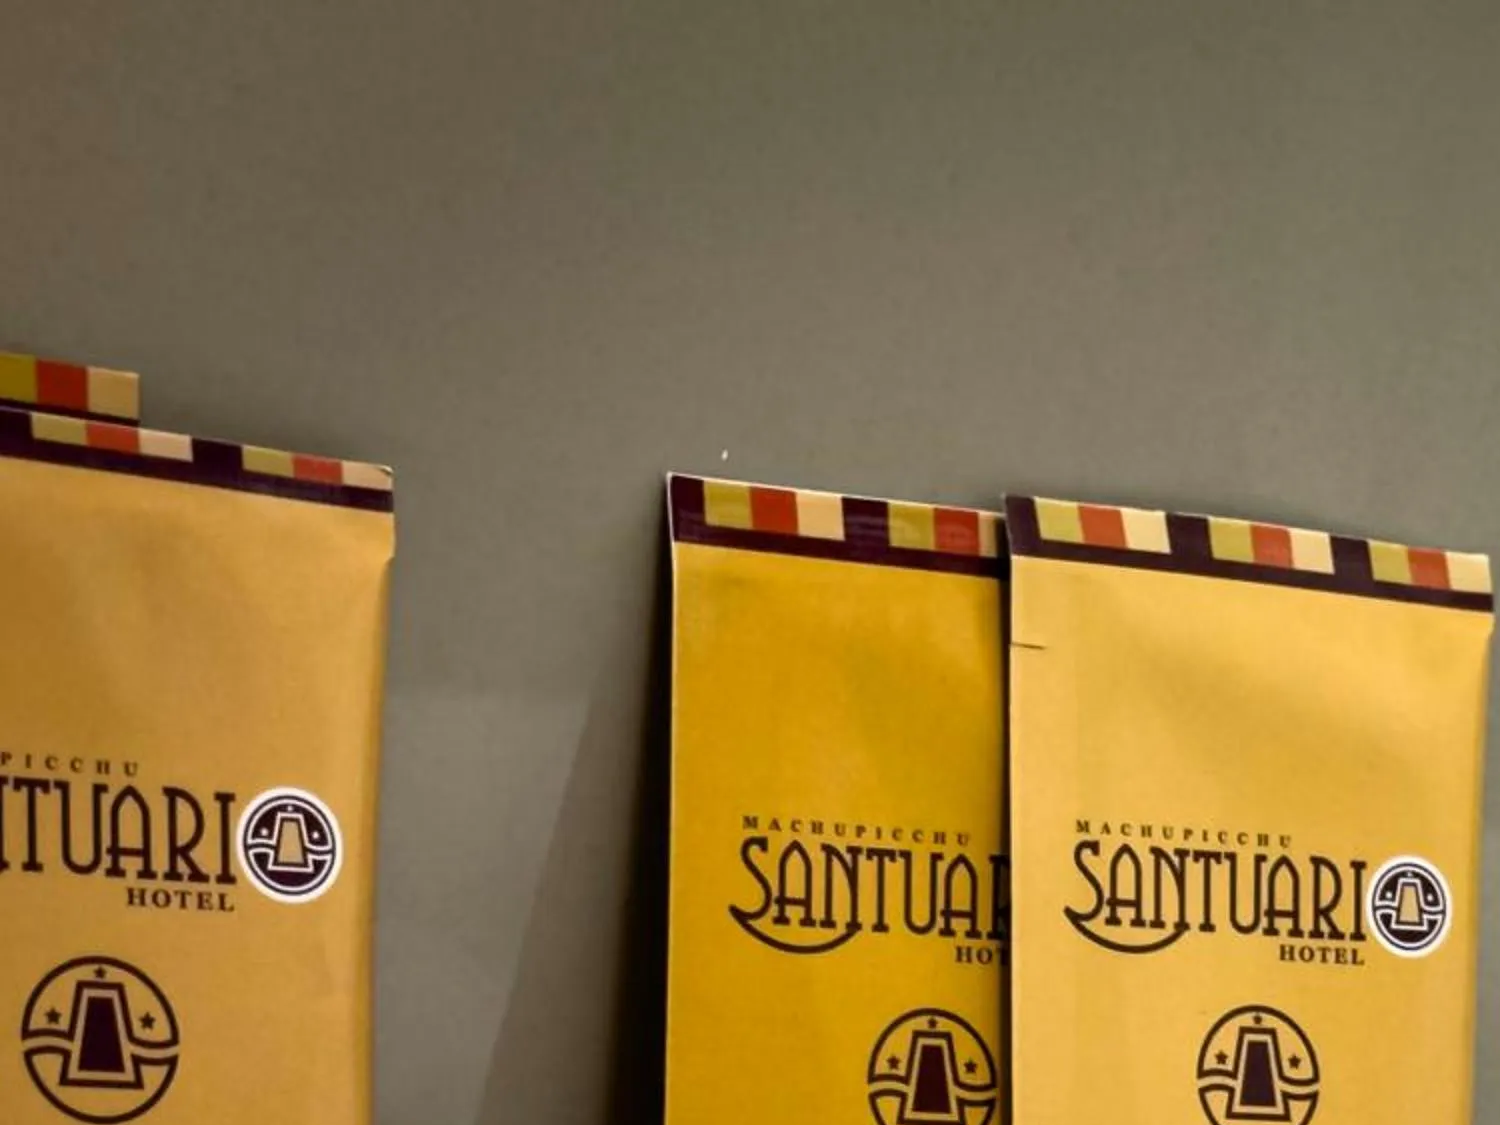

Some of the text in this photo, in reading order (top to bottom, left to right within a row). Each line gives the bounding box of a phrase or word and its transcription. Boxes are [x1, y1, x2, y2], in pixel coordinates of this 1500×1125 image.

[742, 814, 971, 848] MACHUPICCHU
[1074, 818, 1293, 849] MACHUPICCHU
[126, 887, 235, 912] HOTEL
[1278, 943, 1366, 967] HOTEL
